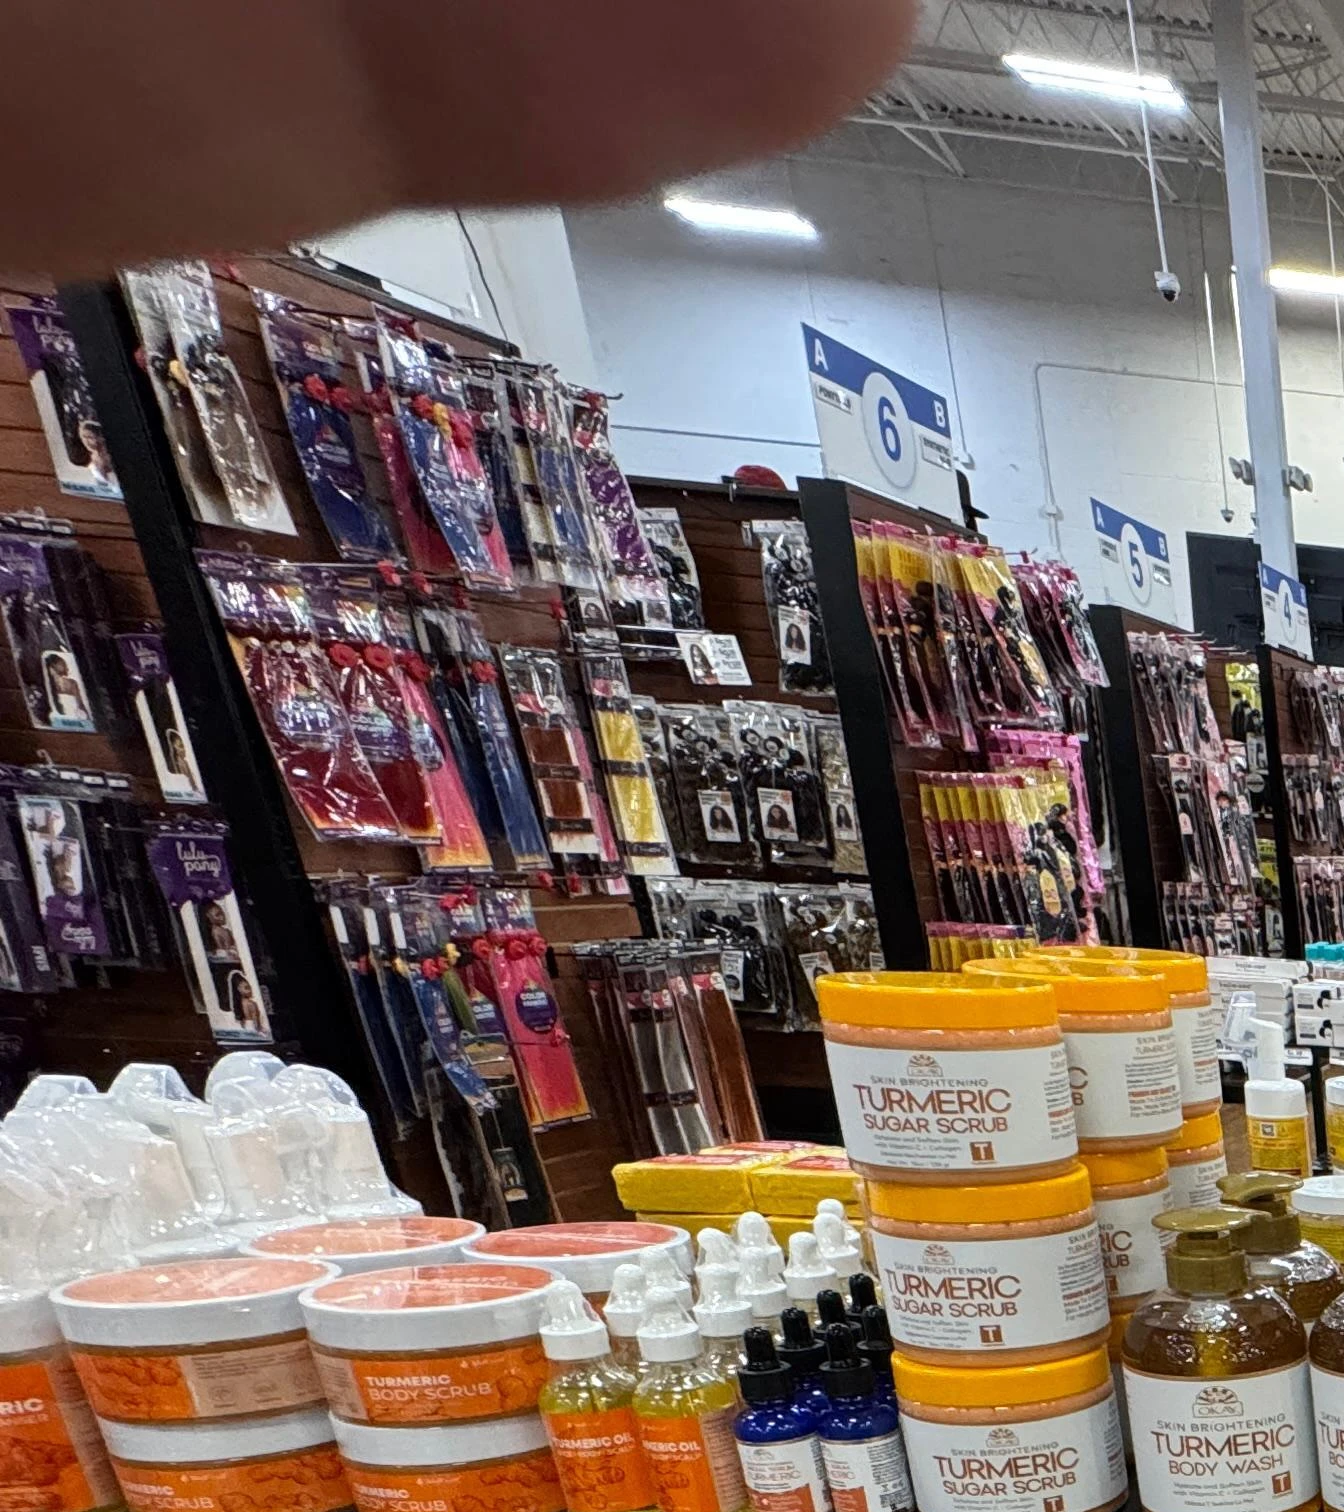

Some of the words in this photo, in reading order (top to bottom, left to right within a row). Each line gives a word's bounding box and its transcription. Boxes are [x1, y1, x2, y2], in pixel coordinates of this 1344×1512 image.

[814, 339, 828, 371] A
[934, 401, 946, 427] B
[878, 397, 901, 462] 6
[1130, 544, 1143, 588] 5
[1283, 592, 1291, 628] 4
[853, 1085, 1012, 1115] TURMERIC
[863, 1113, 929, 1132] SUGAR
[936, 1117, 1008, 1134] SCRUB
[885, 1269, 1022, 1300] TURMERIC
[893, 1299, 944, 1316] SUGAR
[950, 1301, 1017, 1317] SCRUB
[367, 1388, 423, 1402] BODY
[425, 1382, 493, 1399] SCRUB
[1157, 1420, 1186, 1432] SKIN
[1190, 1413, 1286, 1432] BRIGHTENING
[551, 1436, 612, 1450] TURMERIC
[613, 1434, 635, 1447] OIL
[1151, 1424, 1296, 1458] TURMERIC
[933, 1447, 1080, 1480] TURMERIC
[1168, 1461, 1218, 1477] BODY
[1226, 1454, 1284, 1476] WASH
[943, 1481, 1009, 1496] SUGAR
[1013, 1471, 1076, 1494] SCRUB
